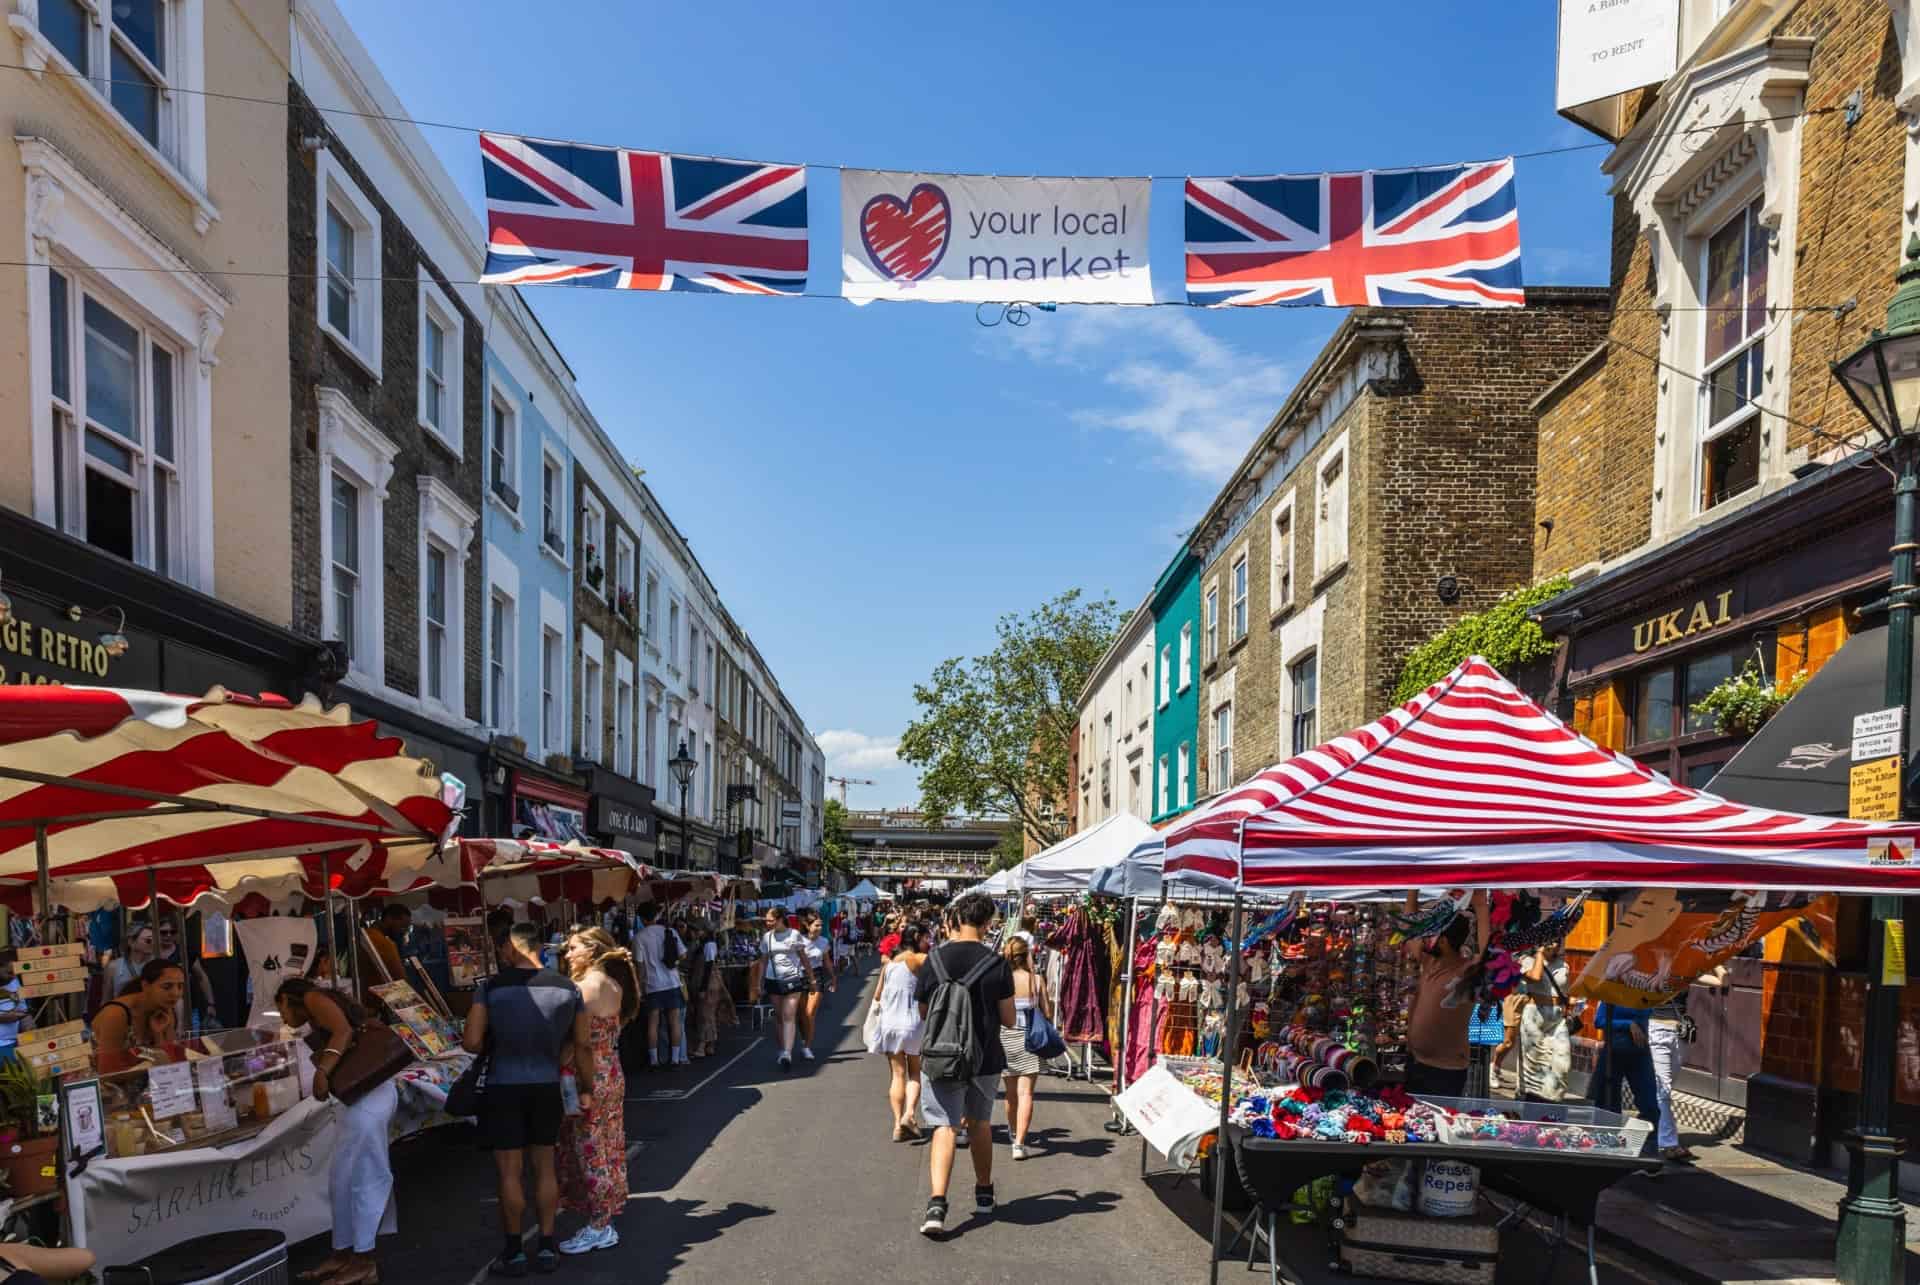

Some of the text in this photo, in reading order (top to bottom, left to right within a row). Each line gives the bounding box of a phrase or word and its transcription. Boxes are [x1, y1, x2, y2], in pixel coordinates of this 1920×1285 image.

[1588, 4, 1596, 13] A
[1592, 38, 1645, 63] TO RENT
[969, 204, 1127, 239] your local
[968, 246, 1131, 281] market
[1632, 588, 1733, 652] UKAI
[0, 619, 33, 656] GE
[41, 627, 108, 677] RETRO
[1425, 1176, 1473, 1194] Repea
